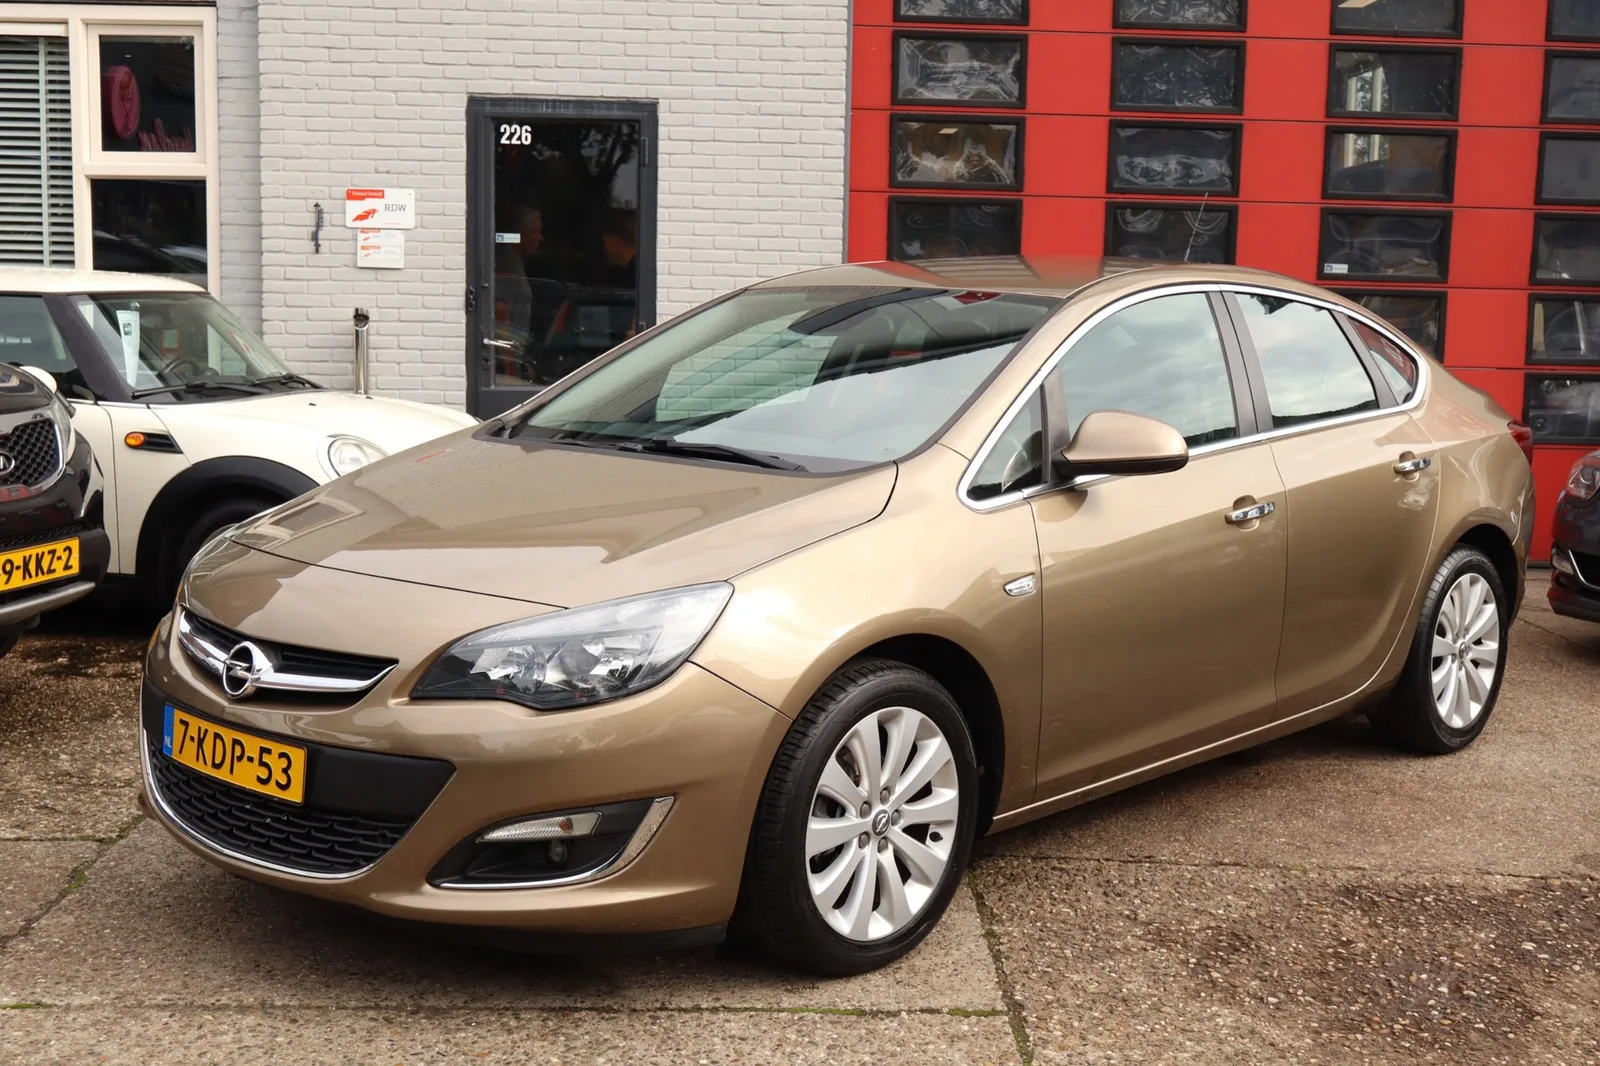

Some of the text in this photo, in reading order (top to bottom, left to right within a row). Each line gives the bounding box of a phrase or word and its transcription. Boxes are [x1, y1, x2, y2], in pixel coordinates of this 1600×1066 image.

[500, 124, 532, 145] 226
[384, 203, 407, 212] RDW
[1, 545, 73, 585] 9-KKZ-2
[178, 718, 293, 791] 7-KDP-53
